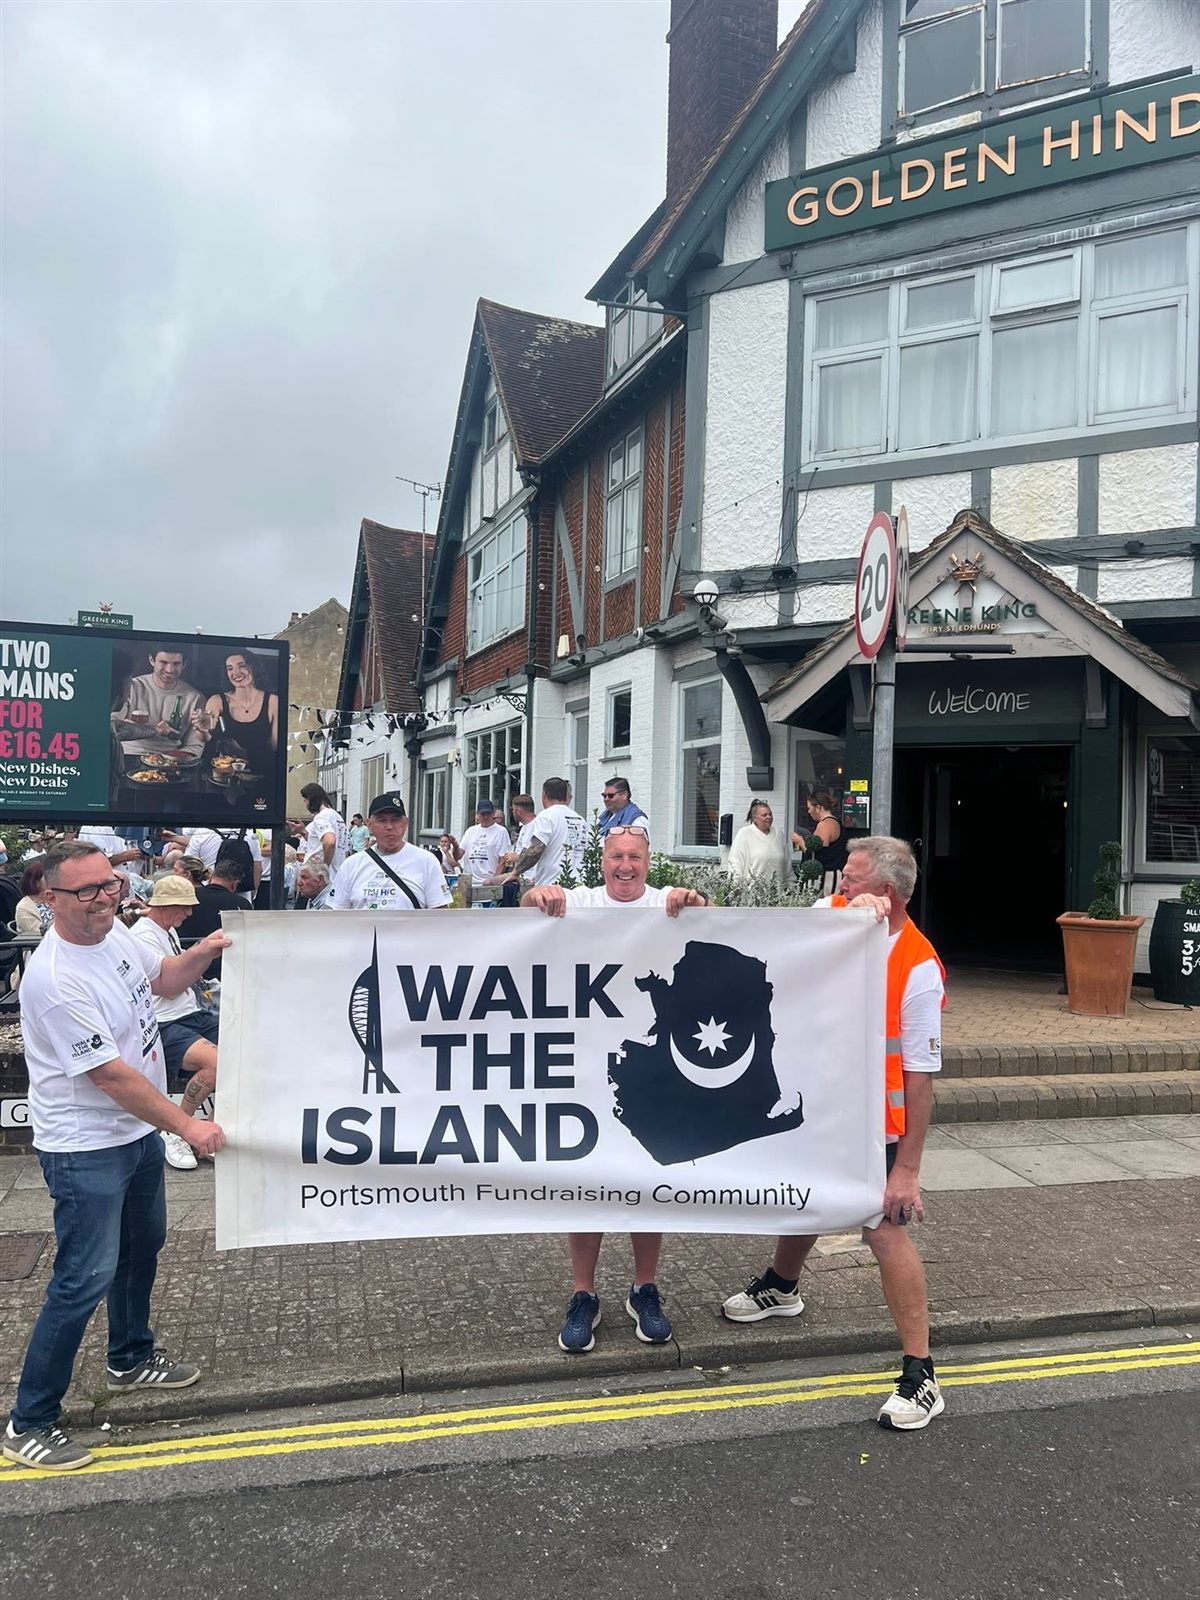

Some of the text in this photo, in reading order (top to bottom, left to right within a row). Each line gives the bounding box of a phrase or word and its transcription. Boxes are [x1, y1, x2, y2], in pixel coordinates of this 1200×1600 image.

[786, 93, 1200, 227] GOLDEN HIND
[861, 552, 889, 622] 20
[81, 615, 109, 624] GREENE
[111, 618, 129, 626] KING
[907, 603, 1037, 624] REENE KING
[958, 623, 1002, 632] EDMUNDS
[0, 638, 50, 669] TWO
[0, 699, 43, 729] FOR
[929, 686, 1031, 714] WELCOME
[0, 730, 80, 761] £16.45
[30, 763, 81, 777] Dishes,
[30, 776, 69, 788] Deals
[1181, 939, 1194, 956] 3
[1181, 956, 1193, 976] 5
[396, 963, 624, 1022] WALK
[420, 1031, 575, 1092] THE
[301, 1102, 600, 1166] ISLAND
[301, 1182, 811, 1211] Portsmouth Fundraising Community
